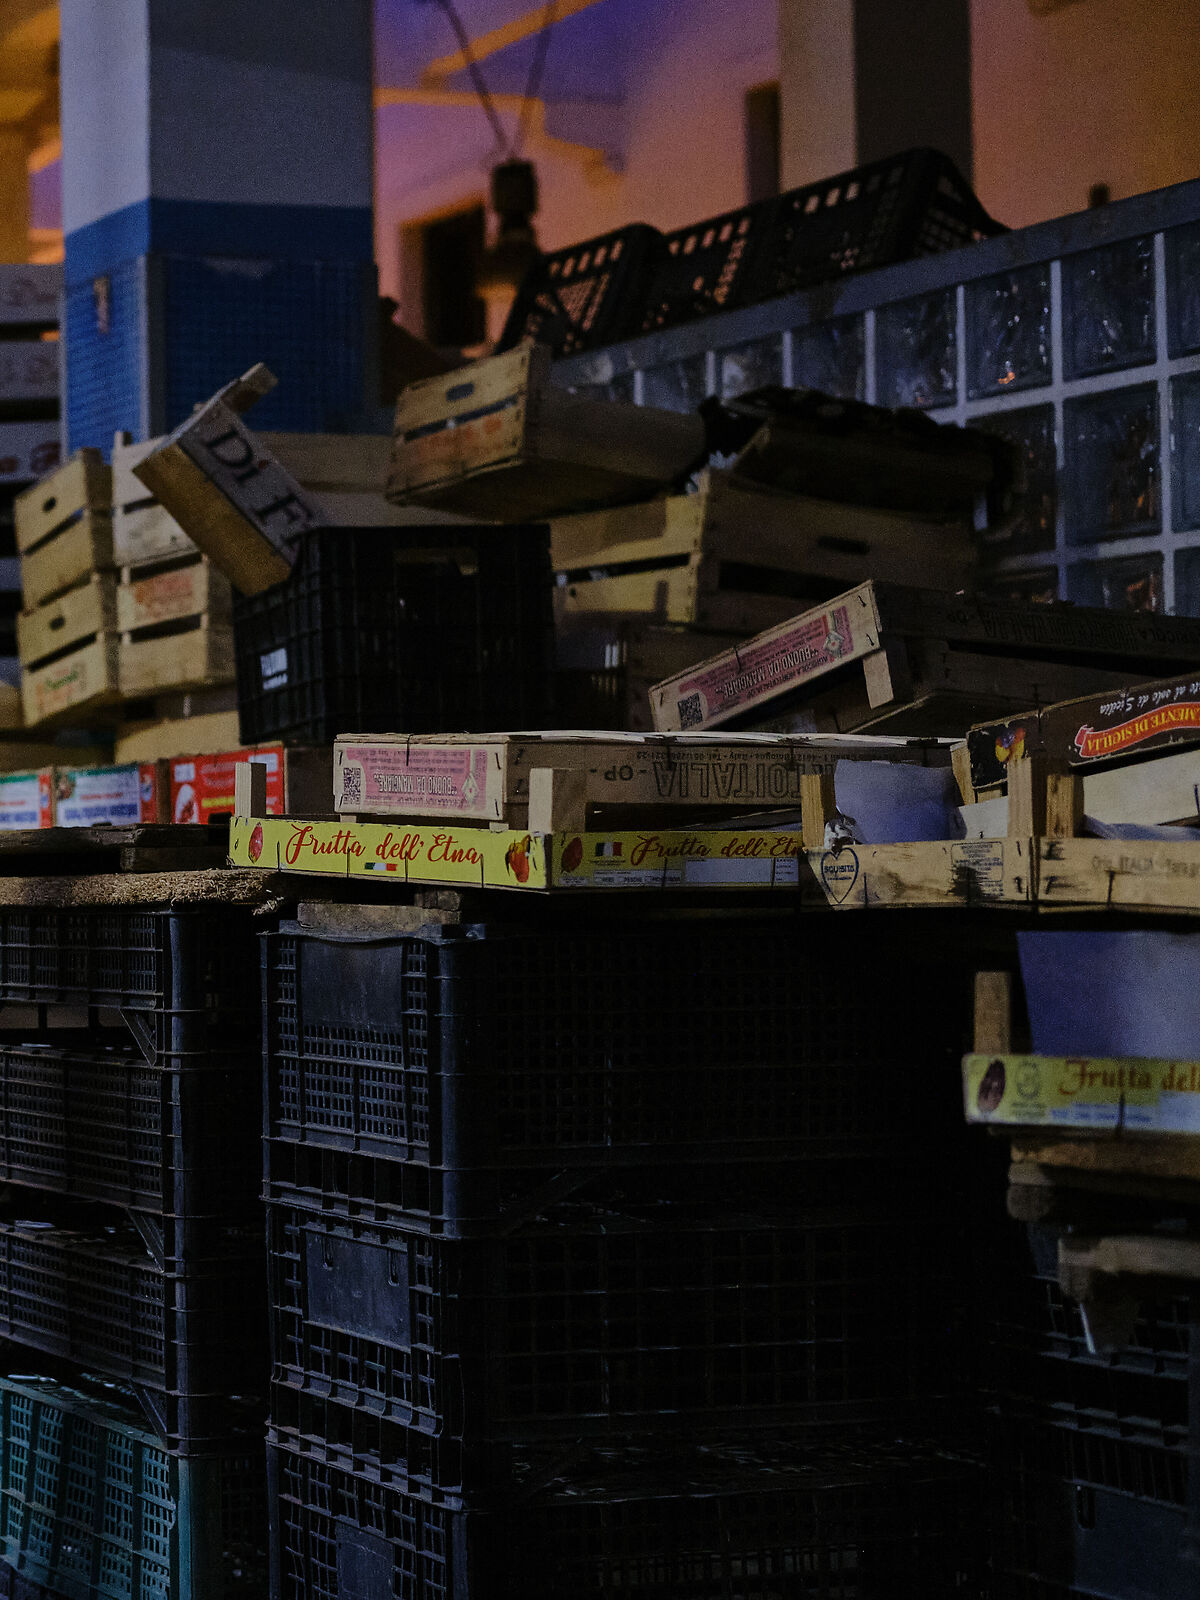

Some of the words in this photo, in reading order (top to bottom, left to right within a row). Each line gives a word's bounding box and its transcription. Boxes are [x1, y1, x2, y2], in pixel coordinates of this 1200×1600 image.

[1099, 696, 1133, 716] Sicilia
[1137, 693, 1149, 709] di
[1152, 706, 1200, 729] MENTE
[1135, 721, 1149, 736] DI
[1087, 729, 1132, 752] SICILIA
[604, 764, 634, 782] OP
[416, 774, 427, 794] DA
[285, 824, 366, 864] Frutta
[427, 833, 484, 864] Etna
[630, 835, 710, 866] Frutta
[769, 836, 801, 858] Etn
[1058, 1058, 1151, 1095] Frutta
